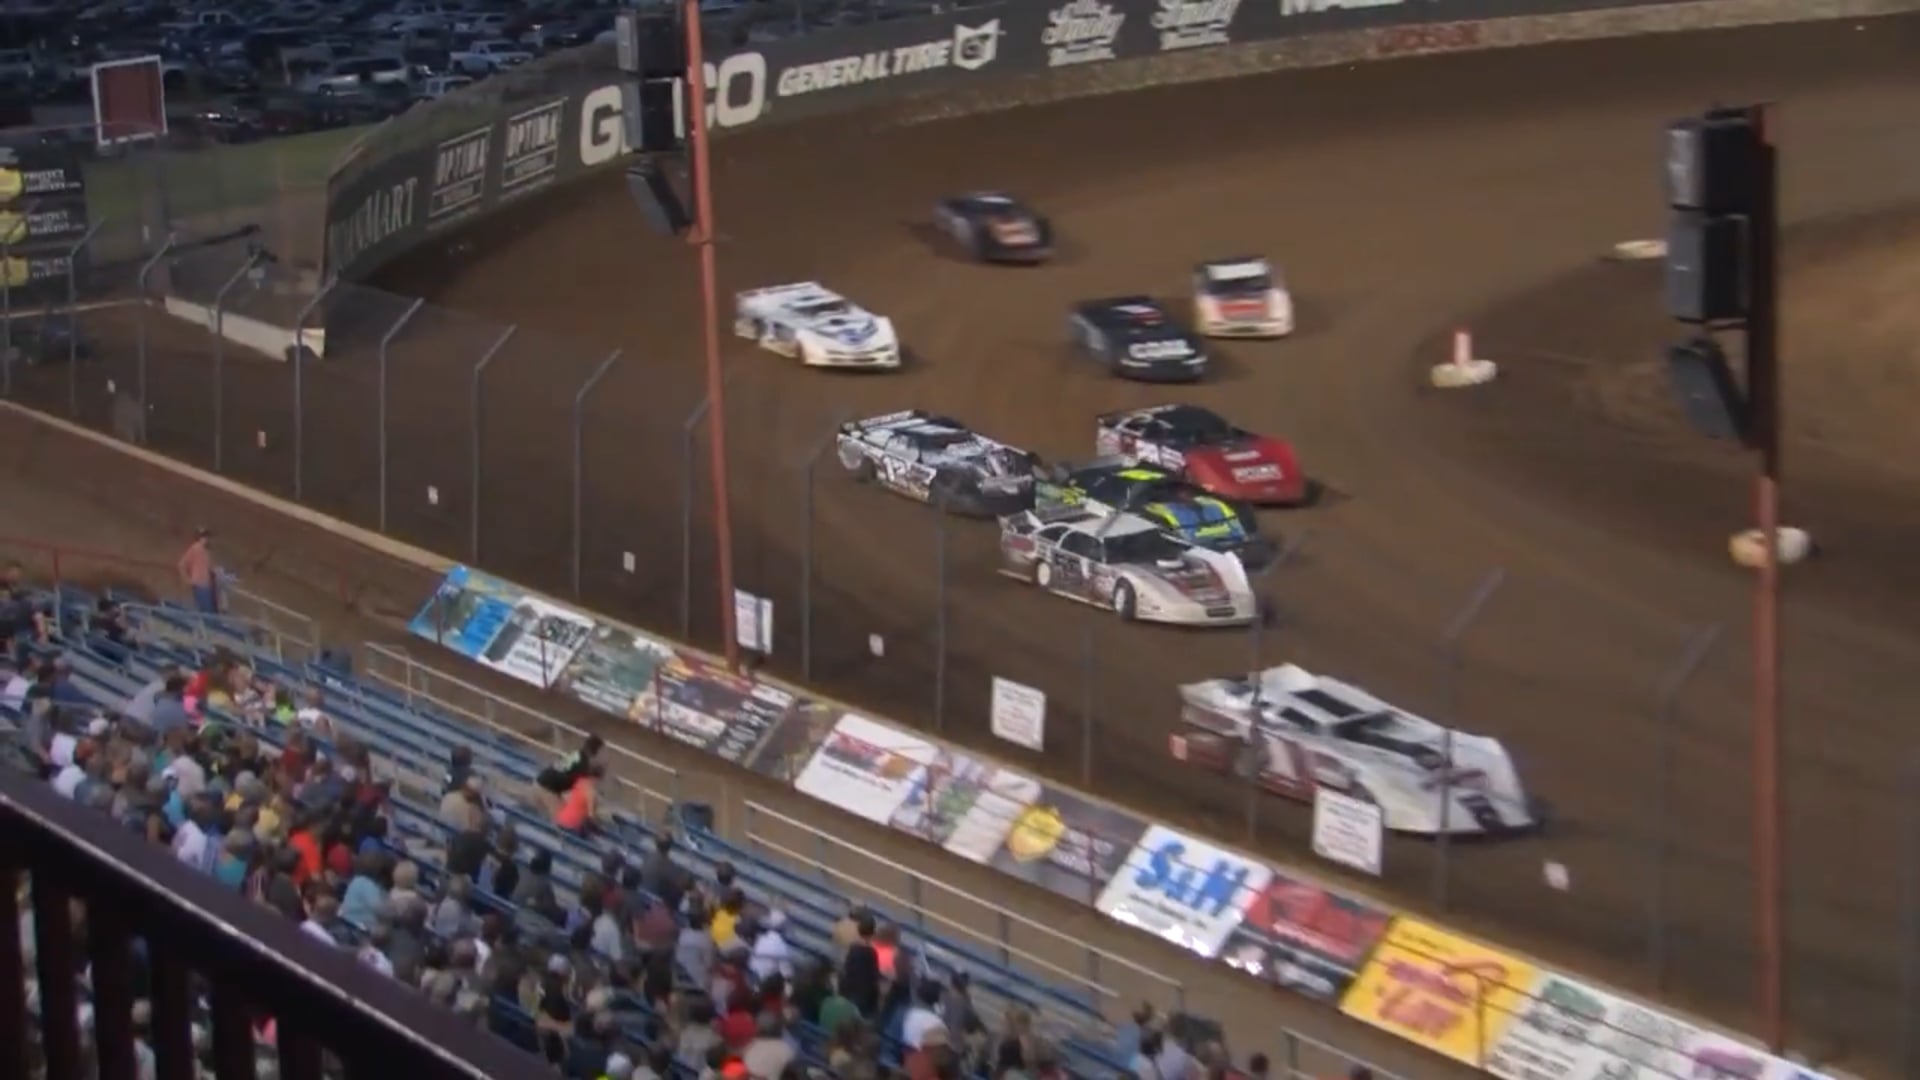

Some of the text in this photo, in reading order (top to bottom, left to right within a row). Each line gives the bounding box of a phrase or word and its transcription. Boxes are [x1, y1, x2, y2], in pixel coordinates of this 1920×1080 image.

[777, 40, 953, 96] GENERAL TIRE
[505, 110, 558, 158] OPTIMA
[580, 52, 766, 165] GICO
[437, 138, 486, 186] OPTIMA
